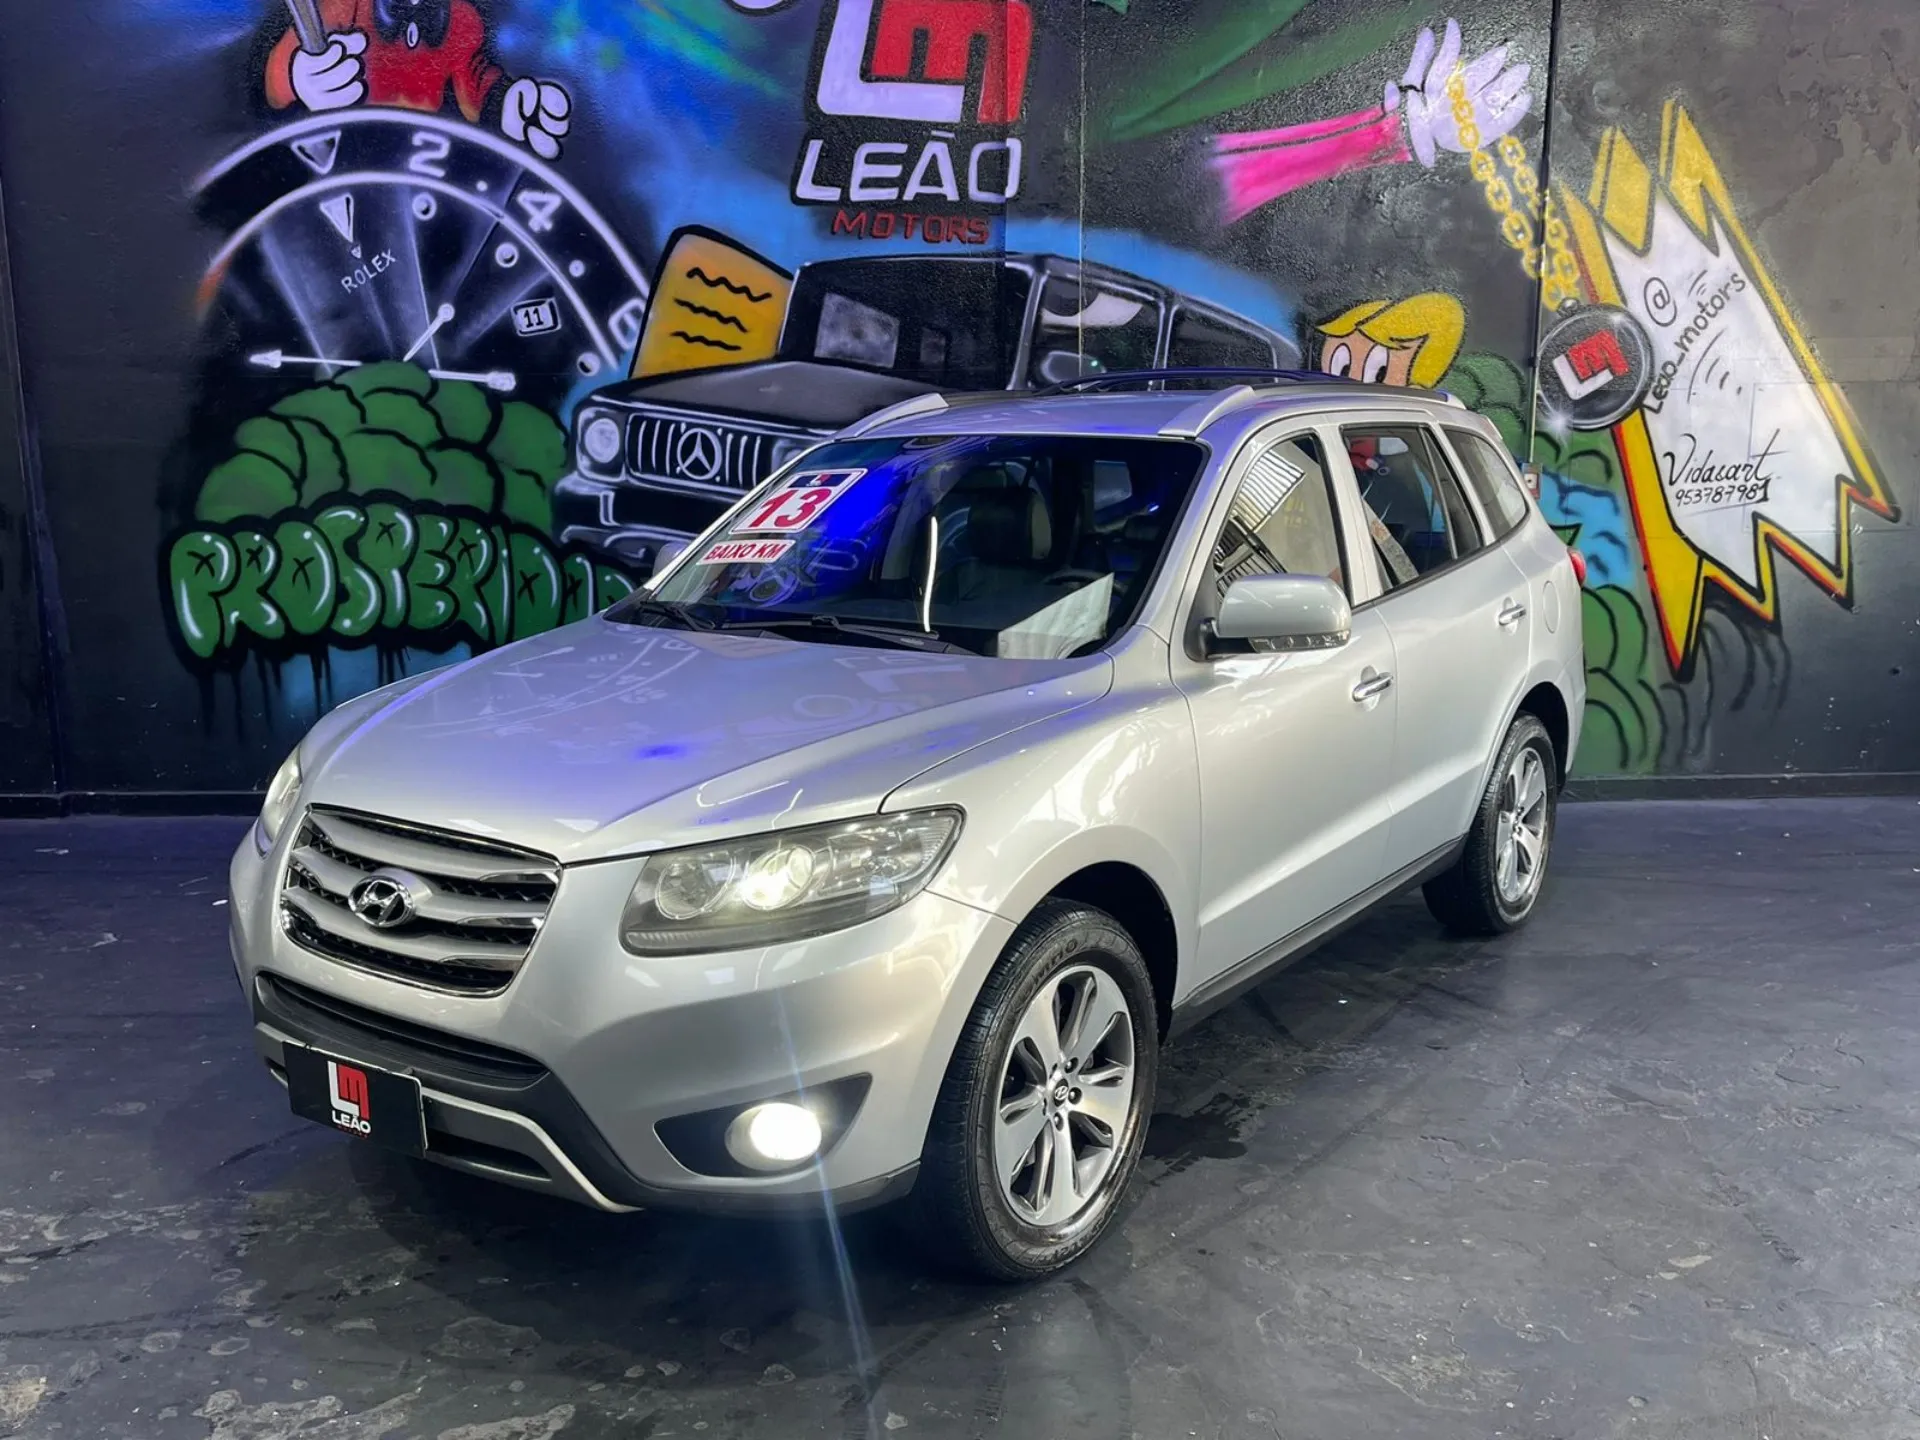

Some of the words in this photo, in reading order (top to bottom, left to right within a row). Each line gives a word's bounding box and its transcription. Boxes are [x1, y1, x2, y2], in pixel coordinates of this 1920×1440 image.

[408, 130, 450, 178] 2
[795, 130, 1022, 204] LEÃO
[517, 190, 563, 232] 4
[831, 209, 990, 244] MOTORS
[341, 249, 396, 293] ROLEX
[523, 307, 544, 328] 11
[749, 487, 832, 528] 13
[704, 543, 757, 560] BAIXO
[752, 542, 788, 558] KM
[331, 1109, 371, 1134] LEÃO
